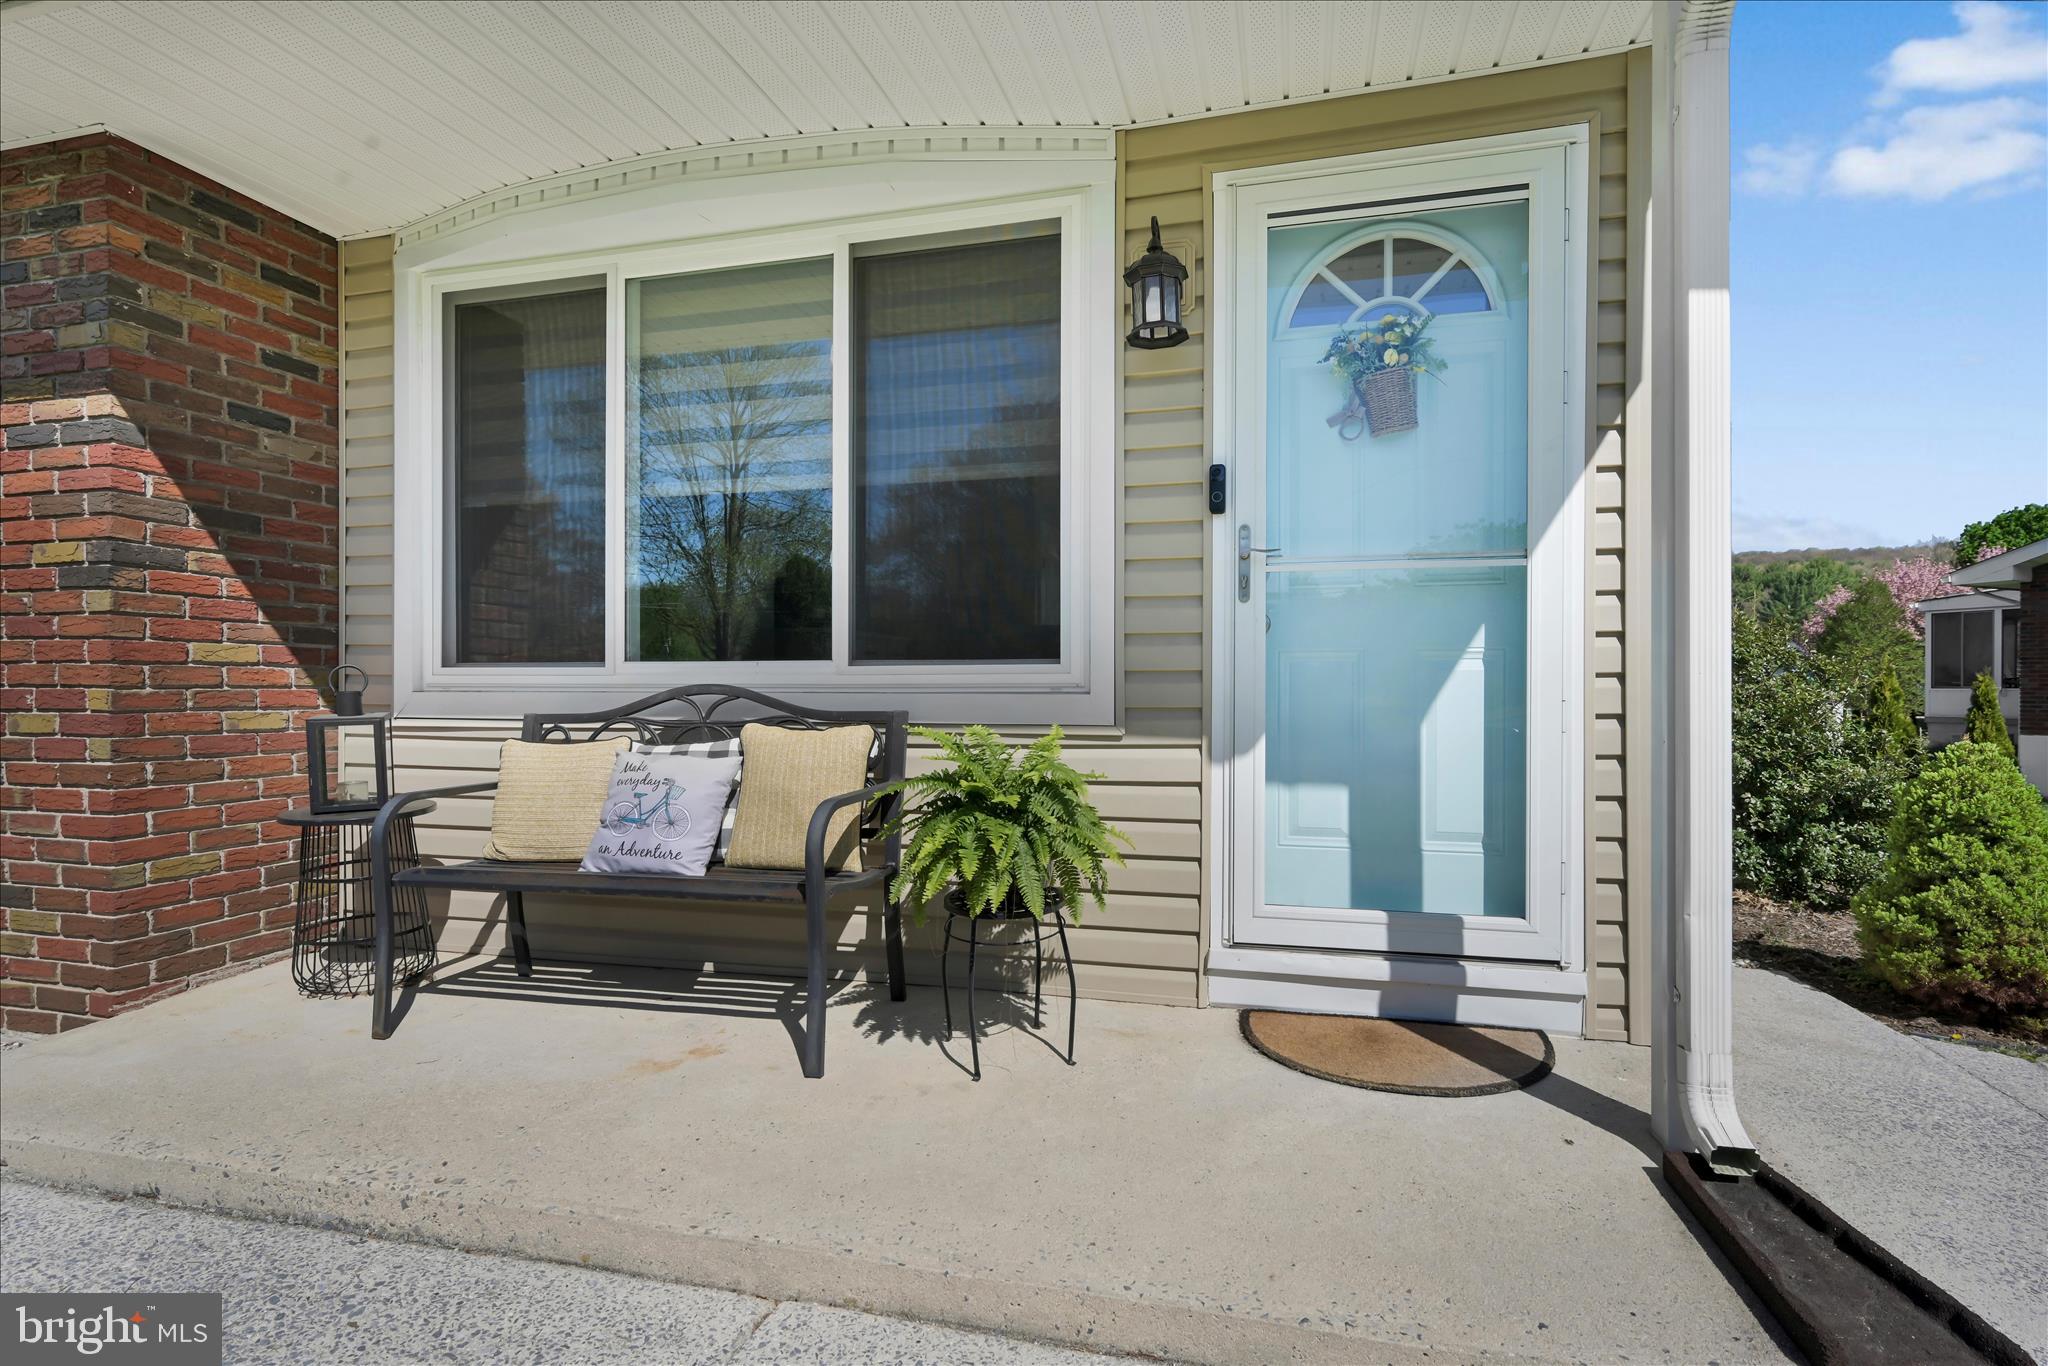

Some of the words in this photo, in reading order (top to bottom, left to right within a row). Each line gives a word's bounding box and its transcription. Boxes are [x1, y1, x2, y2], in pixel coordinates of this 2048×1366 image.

[620, 760, 648, 773] Make
[616, 772, 661, 792] everyday
[598, 845, 612, 855] an
[613, 841, 682, 860] Adventure
